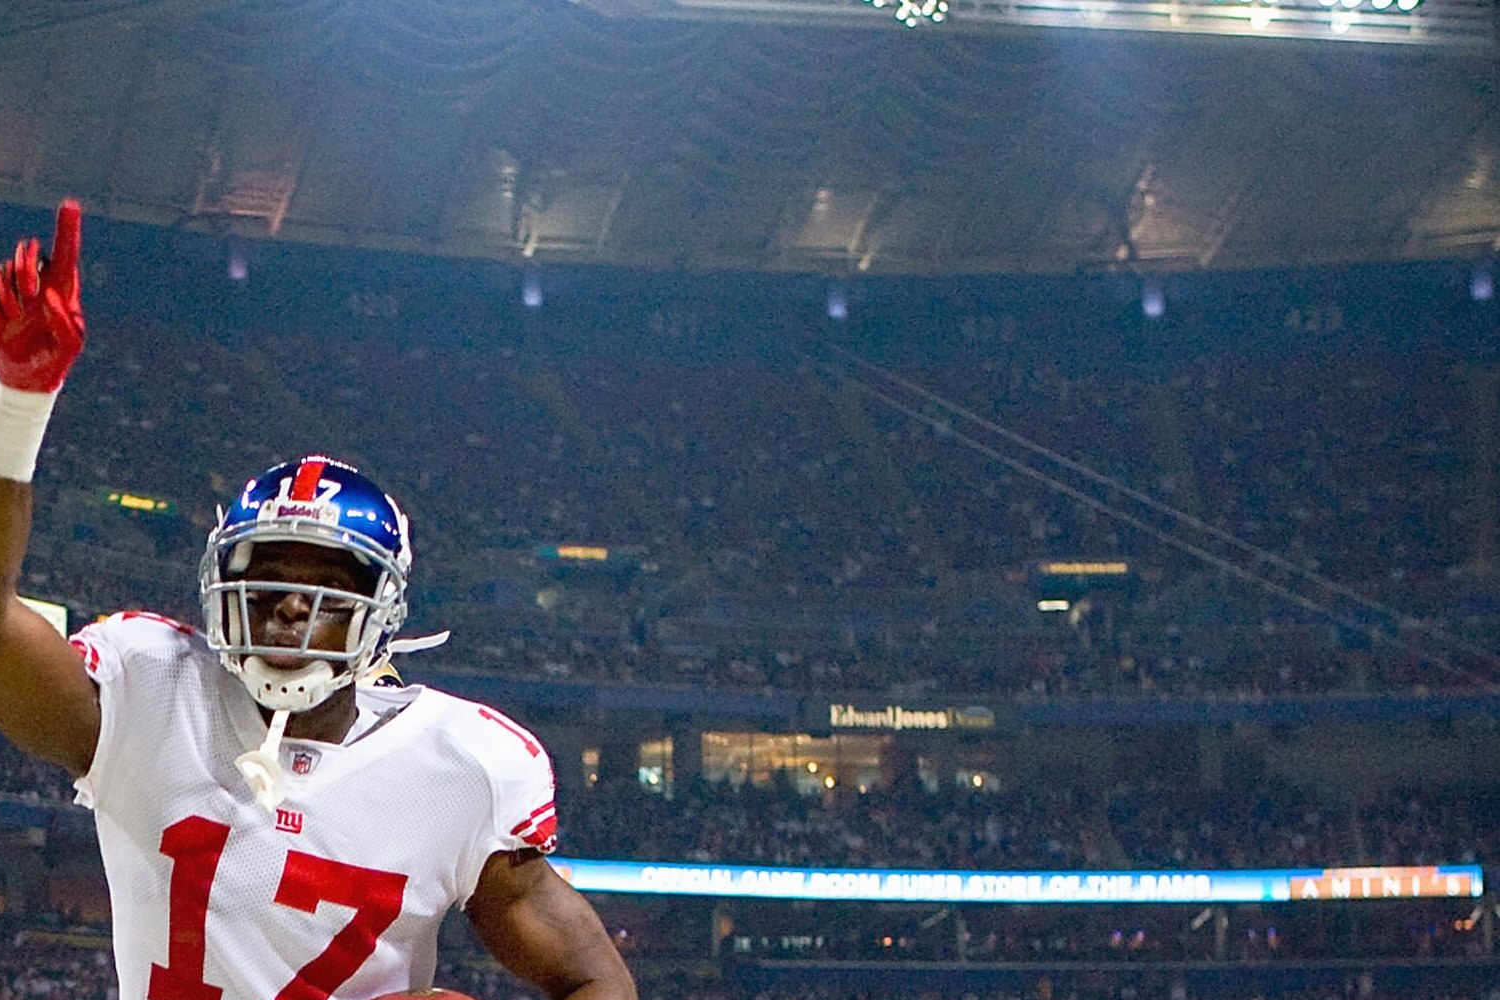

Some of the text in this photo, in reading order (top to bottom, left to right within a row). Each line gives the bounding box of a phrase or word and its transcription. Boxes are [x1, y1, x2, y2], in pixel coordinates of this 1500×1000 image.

[830, 704, 893, 727] Edward
[894, 705, 947, 731] Jones
[1049, 875, 1080, 899] OF
[1086, 875, 1132, 899] THE
[1140, 874, 1210, 899] RAMS
